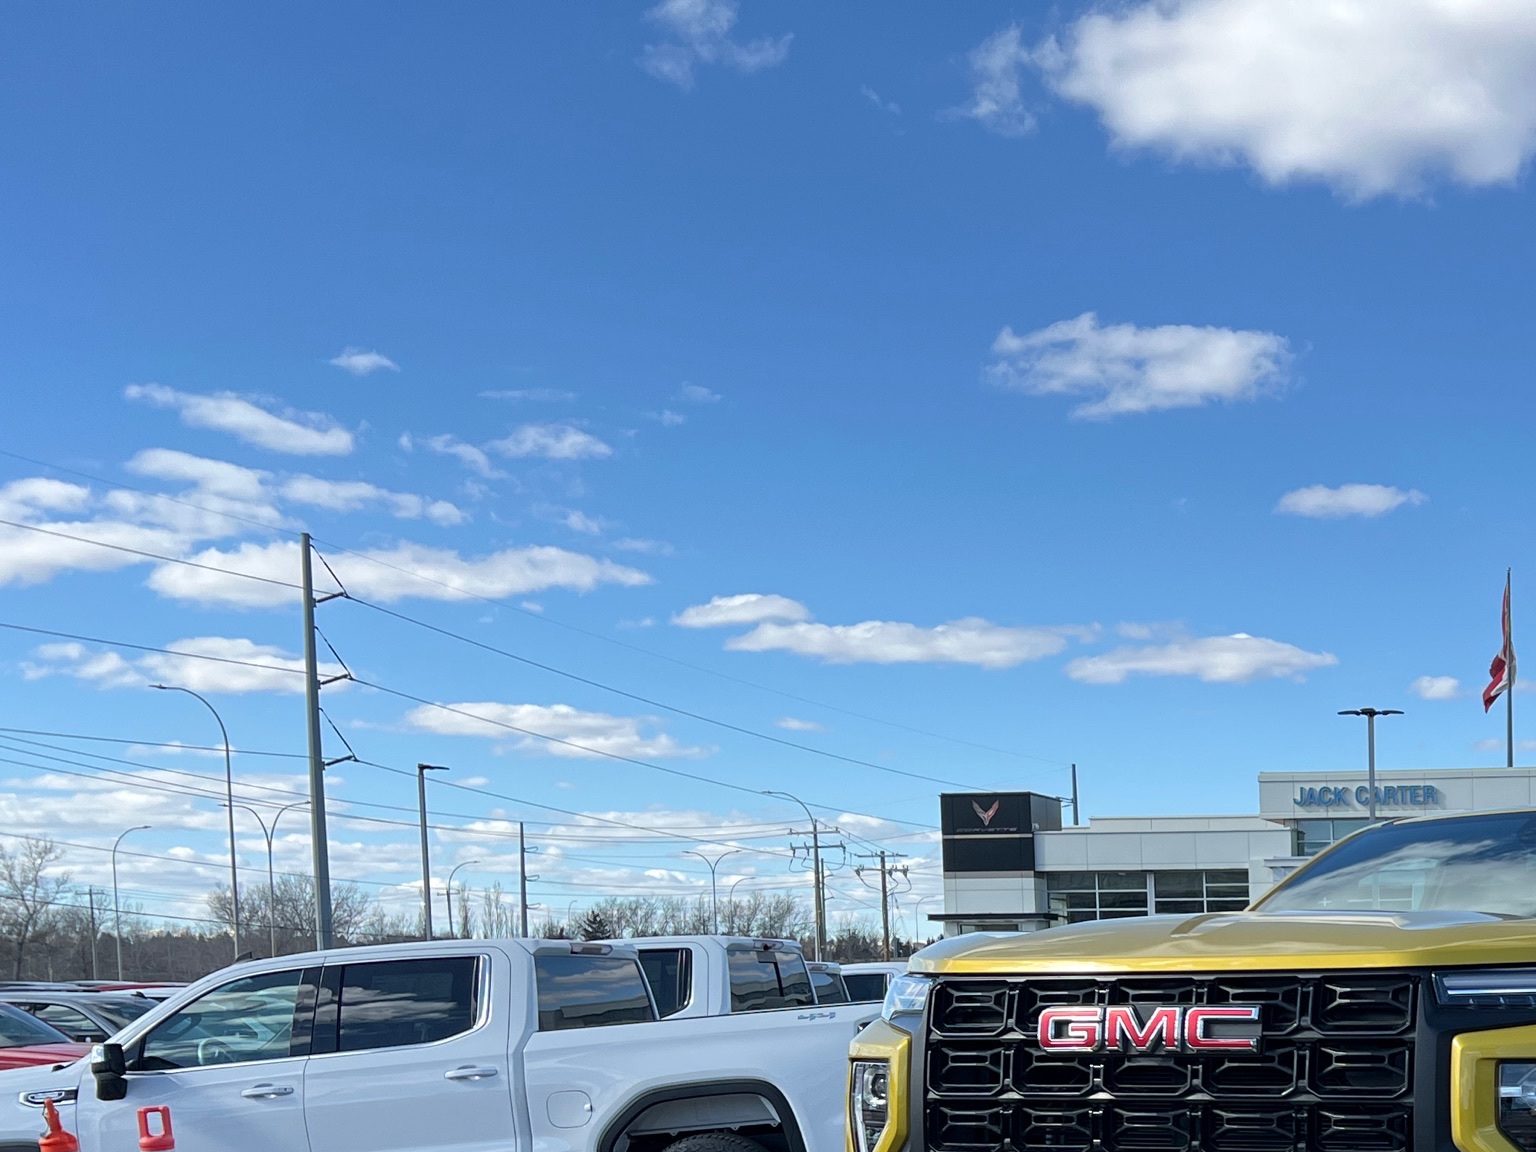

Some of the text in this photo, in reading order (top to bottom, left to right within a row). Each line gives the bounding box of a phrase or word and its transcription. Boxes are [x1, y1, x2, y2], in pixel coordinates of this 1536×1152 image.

[1292, 784, 1439, 808] JACK CARTER
[1037, 1006, 1259, 1052] GMC
